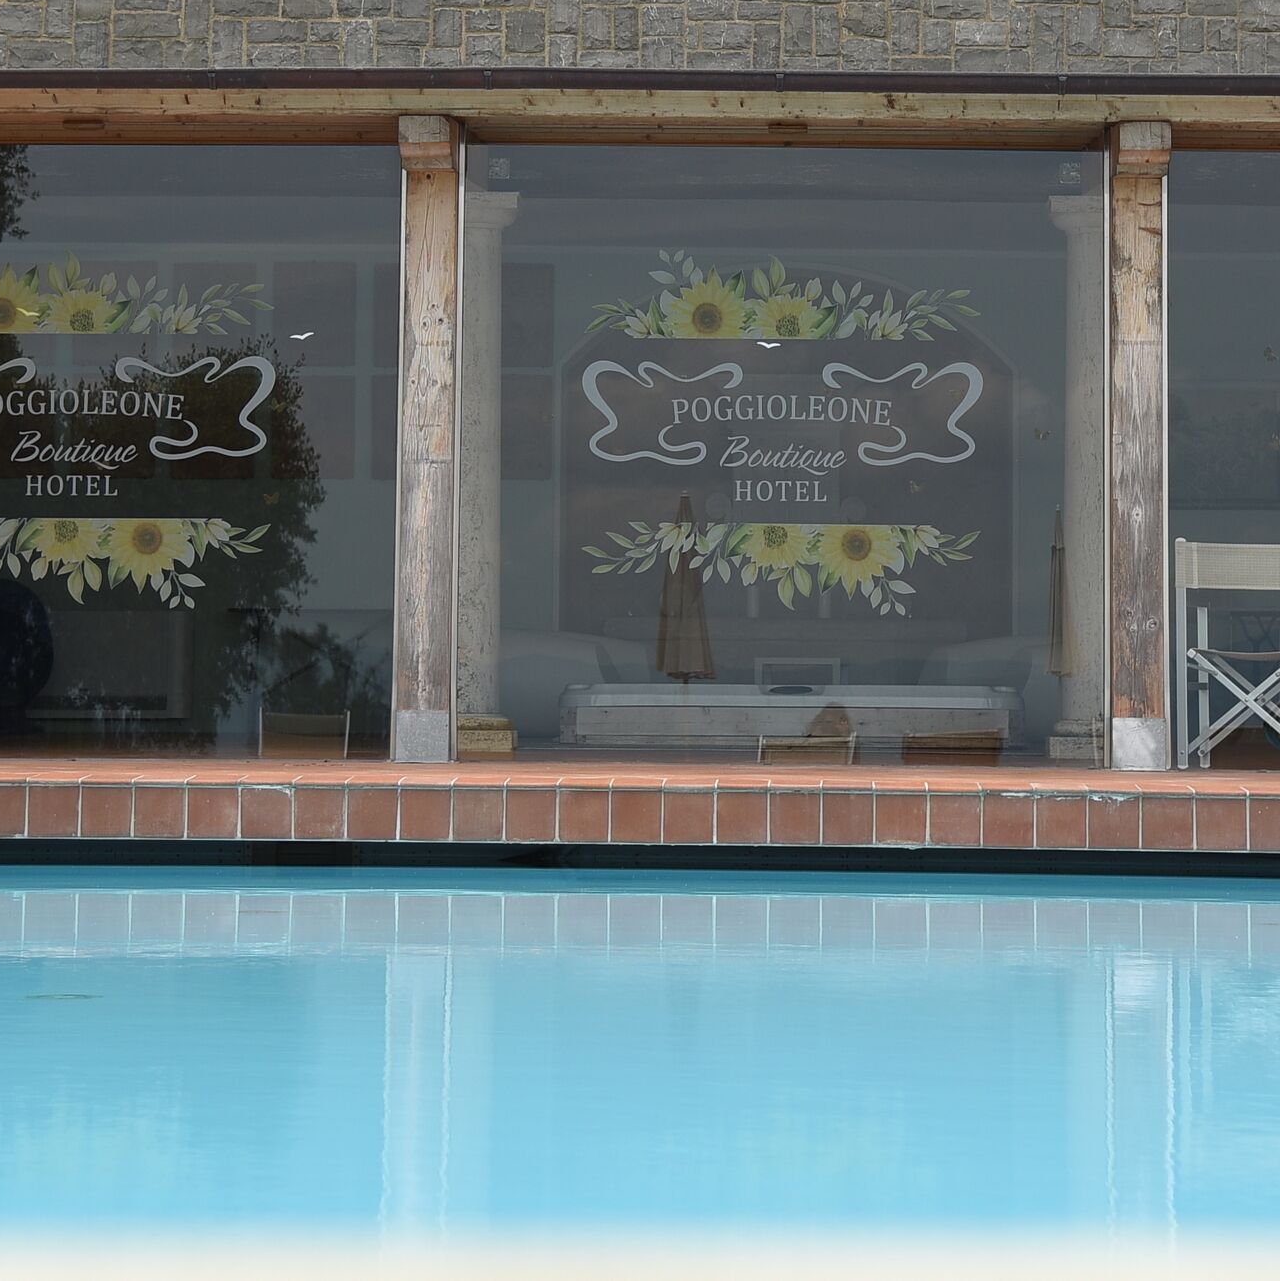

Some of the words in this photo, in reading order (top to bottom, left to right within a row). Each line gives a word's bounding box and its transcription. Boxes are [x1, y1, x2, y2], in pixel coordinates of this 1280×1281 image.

[671, 394, 893, 426] POGGIOLEONE
[10, 431, 138, 469] Boutique
[720, 435, 848, 475] Boutique
[25, 474, 119, 496] HOTEL
[734, 480, 827, 503] HOTEL
